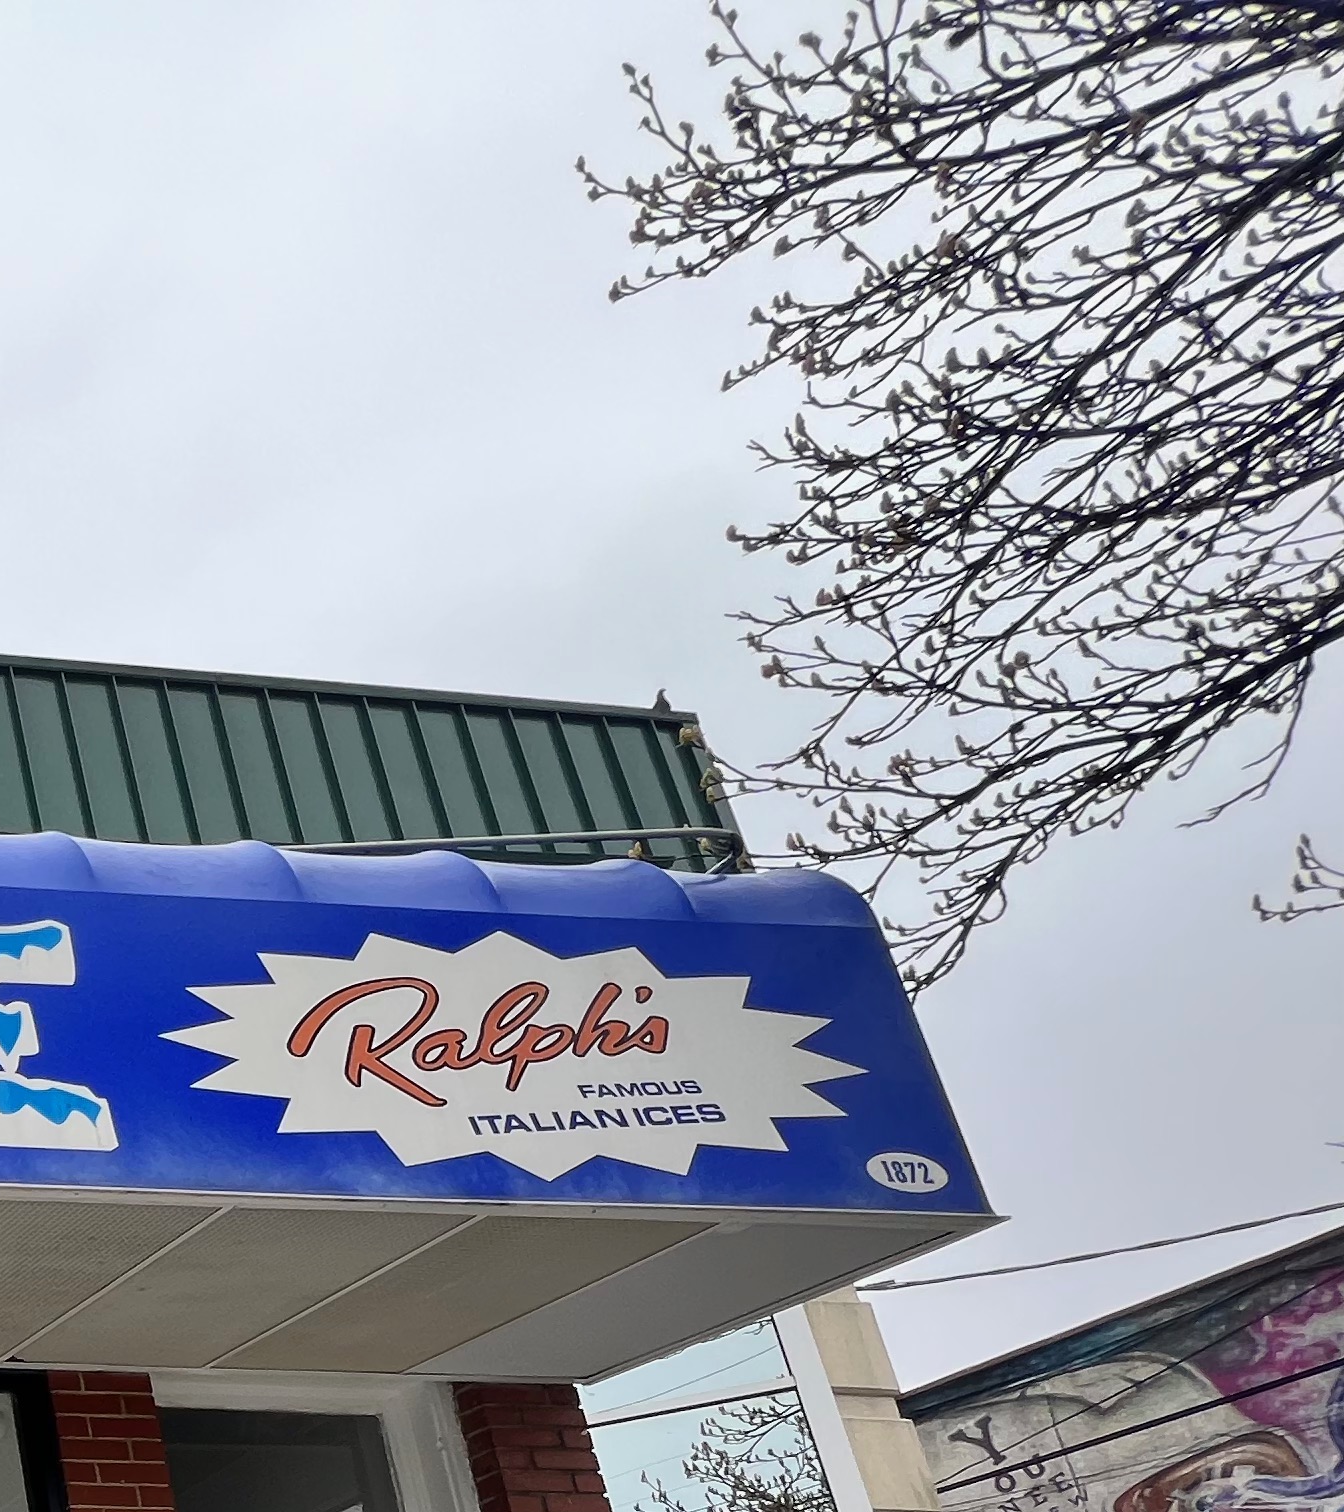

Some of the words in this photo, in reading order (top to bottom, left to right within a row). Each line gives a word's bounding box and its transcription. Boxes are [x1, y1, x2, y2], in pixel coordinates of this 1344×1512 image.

[286, 976, 670, 1107] Ralph's
[576, 1080, 703, 1099] FAMOUS
[467, 1108, 630, 1136] ITALIAN
[632, 1103, 727, 1128] ICES
[880, 1160, 936, 1185] 1872
